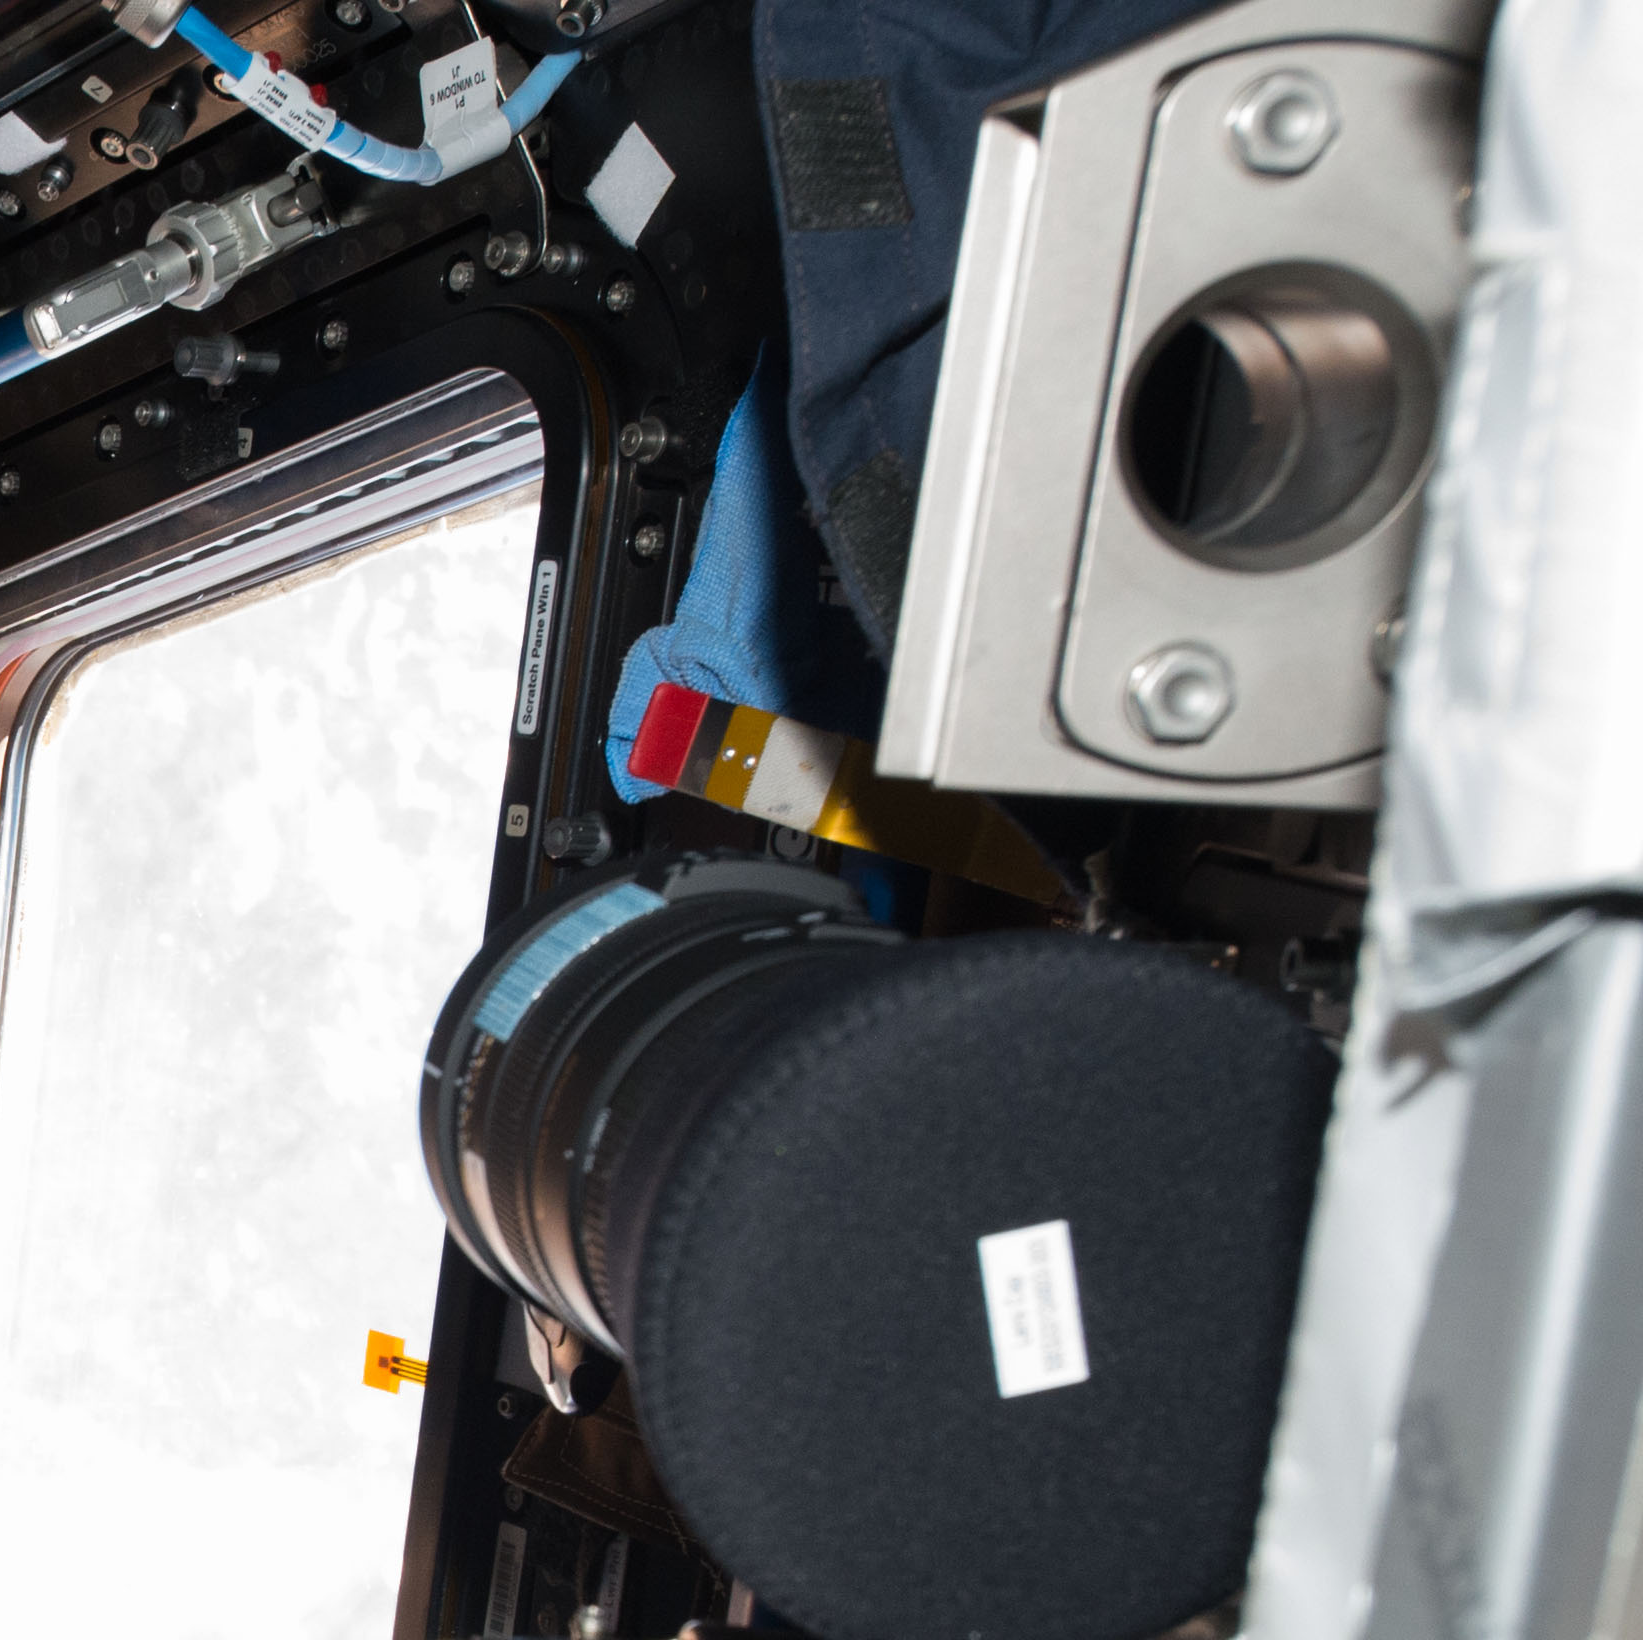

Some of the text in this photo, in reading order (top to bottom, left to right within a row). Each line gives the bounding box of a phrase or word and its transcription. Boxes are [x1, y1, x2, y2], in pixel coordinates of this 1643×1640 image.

[451, 65, 459, 78] J1
[475, 70, 486, 84] TO
[90, 84, 103, 97] 7
[437, 75, 473, 100] WINDOW
[454, 96, 466, 109] P1
[307, 122, 322, 134] Node
[537, 584, 551, 615] Win
[531, 618, 545, 659] Pane
[522, 663, 539, 725] Scratch
[511, 813, 524, 827] 5
